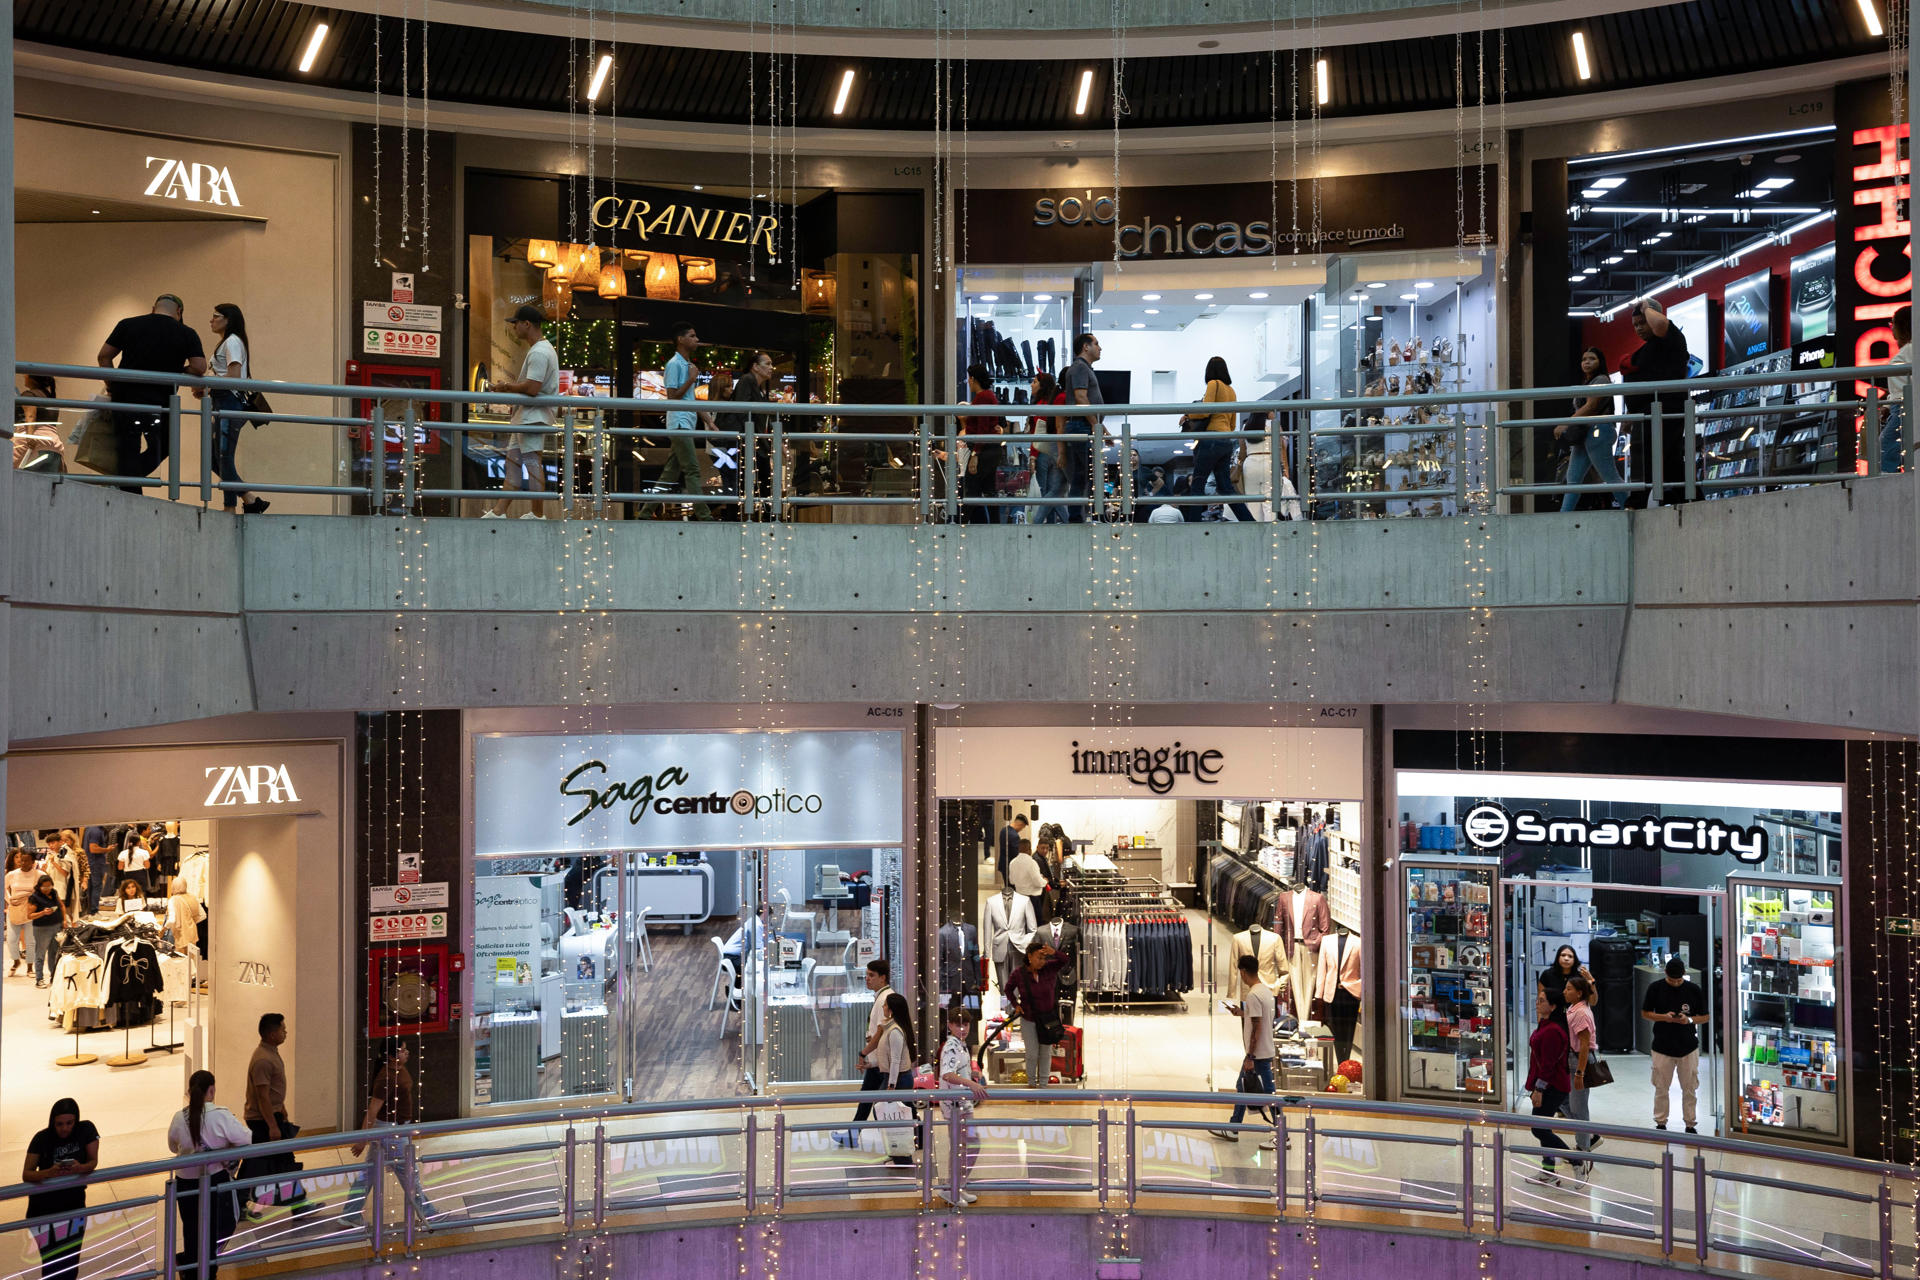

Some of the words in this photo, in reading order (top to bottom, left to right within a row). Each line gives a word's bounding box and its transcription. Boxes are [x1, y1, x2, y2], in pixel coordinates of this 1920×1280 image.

[1788, 102, 1823, 115] L-C19
[144, 156, 244, 207] ZARA
[894, 167, 921, 176] L-C15
[1033, 189, 1117, 225] solo
[591, 196, 778, 256] GRANIER
[1118, 215, 1273, 257] chicas
[1278, 227, 1344, 247] complace
[1347, 227, 1361, 240] tu
[1363, 223, 1404, 239] moda
[1736, 295, 1763, 335] 200W
[1747, 342, 1767, 355] ANKER
[1800, 348, 1825, 364] iPhone
[867, 707, 903, 717] AC-C15
[1320, 707, 1357, 717] AC-C17
[204, 763, 302, 806] ZARA
[1071, 740, 1224, 794] immagine
[560, 759, 689, 826] Saga
[1516, 815, 1762, 860] SmartCity
[239, 961, 274, 987] ZARA
